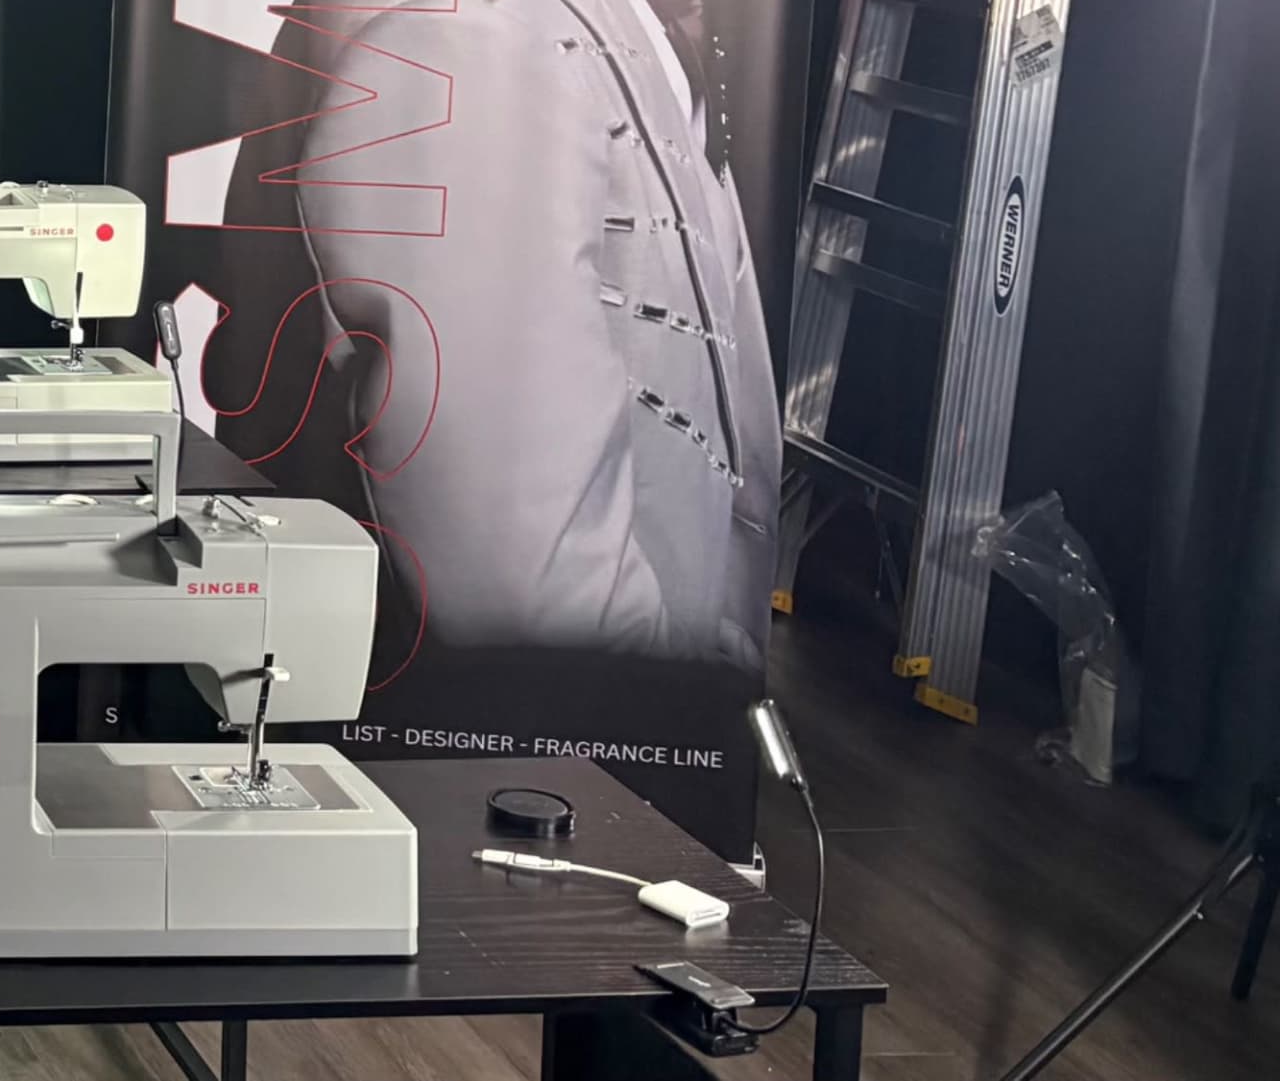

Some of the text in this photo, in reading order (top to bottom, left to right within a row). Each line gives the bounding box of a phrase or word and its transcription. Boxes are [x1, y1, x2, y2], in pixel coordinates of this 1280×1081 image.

[30, 227, 74, 236] SINGER
[999, 204, 1020, 288] WERNER
[187, 582, 259, 594] SINGER
[342, 725, 386, 743] LIST
[405, 728, 513, 752] DESIGNER
[534, 738, 667, 764] FRAGRANCE
[673, 749, 724, 769] LINE
